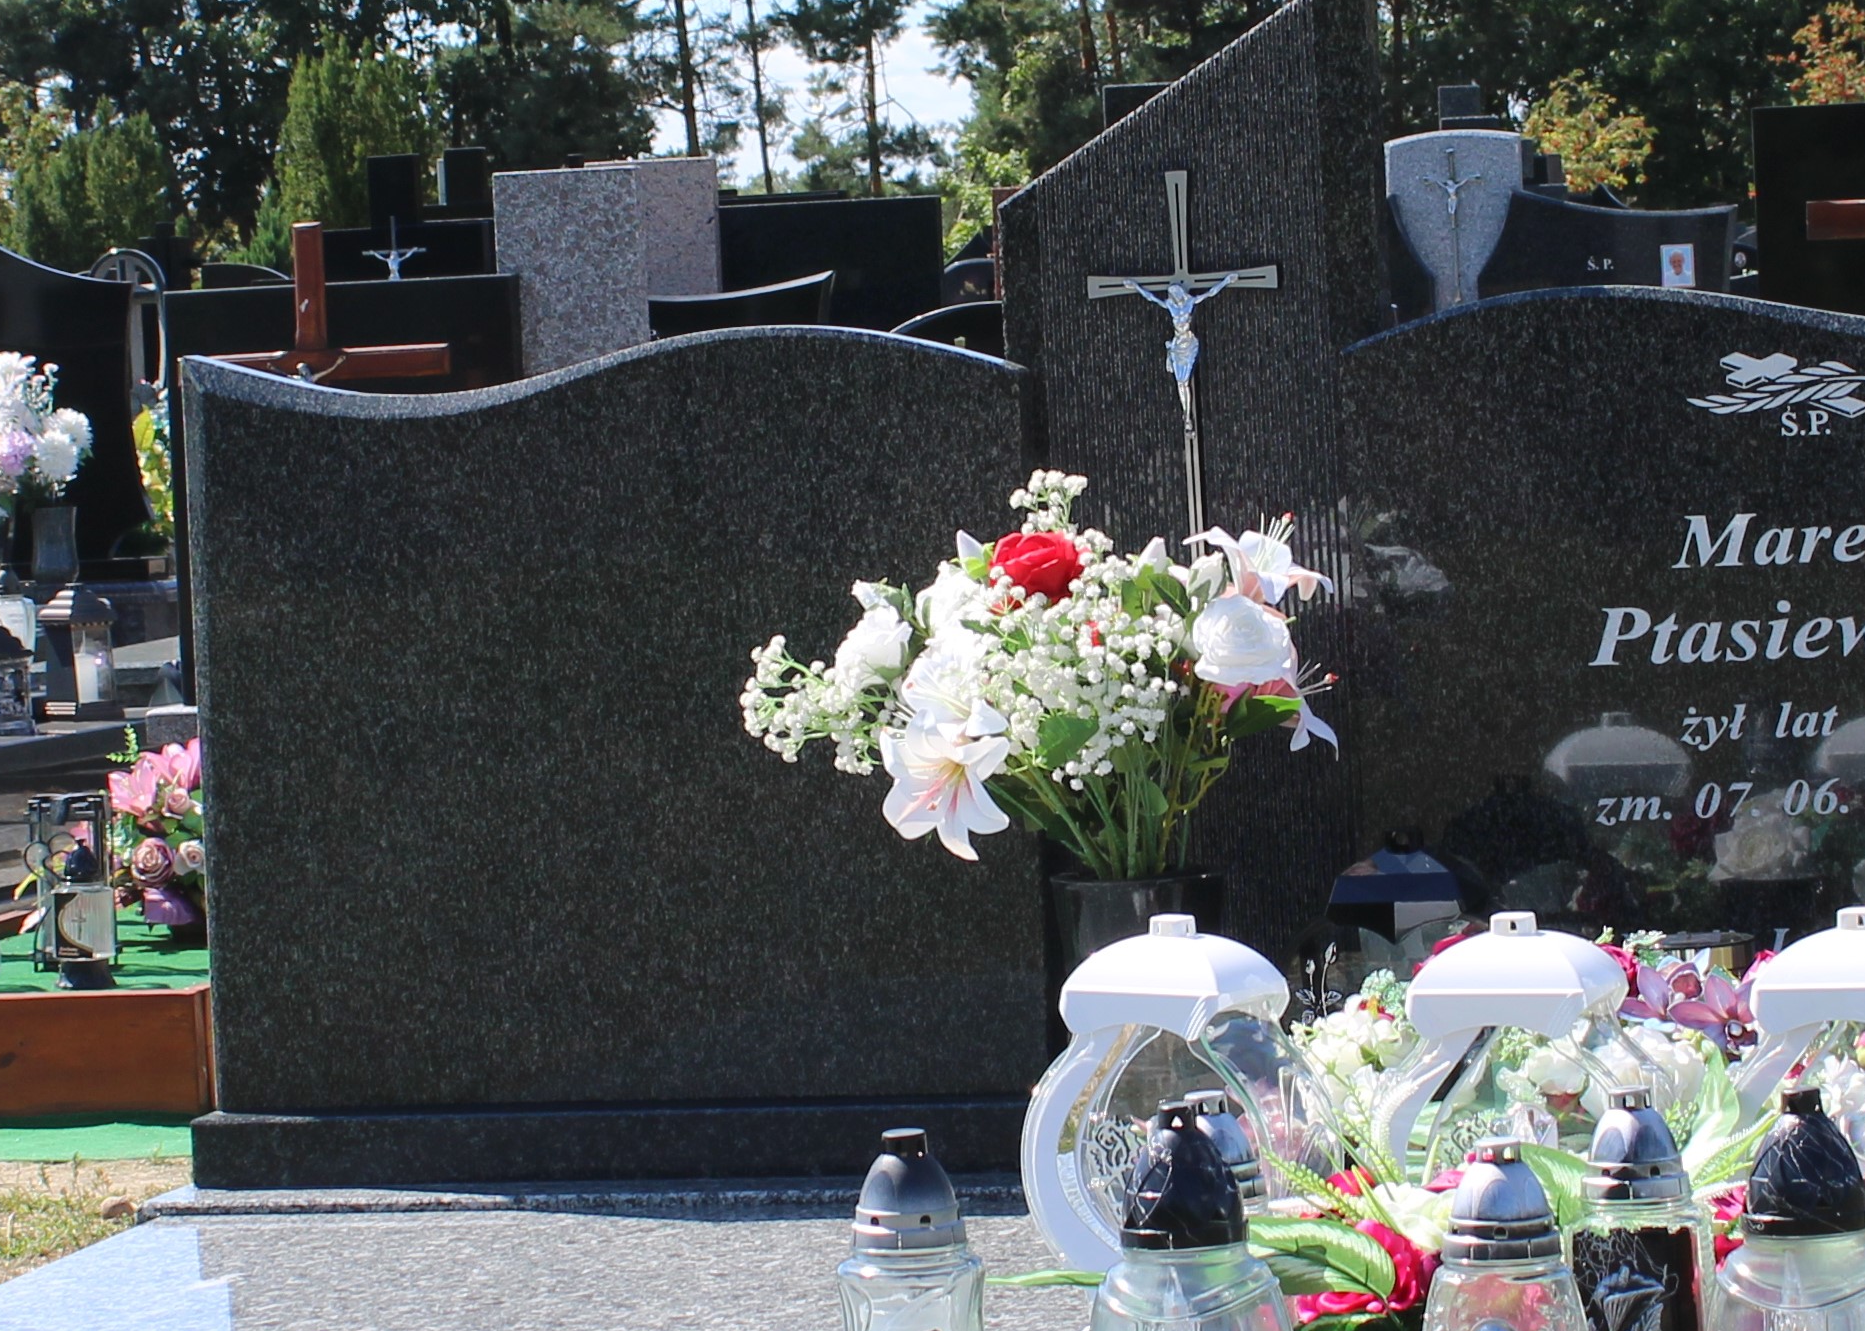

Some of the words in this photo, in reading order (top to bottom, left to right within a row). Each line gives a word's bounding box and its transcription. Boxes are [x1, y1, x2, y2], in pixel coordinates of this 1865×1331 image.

[1780, 405, 1832, 437] Ś.P.
[1680, 703, 1747, 751] żył
[1774, 702, 1838, 740] lat
[1595, 794, 1673, 827] zm.
[1695, 781, 1762, 820] 07.
[1783, 777, 1849, 817] 06.
